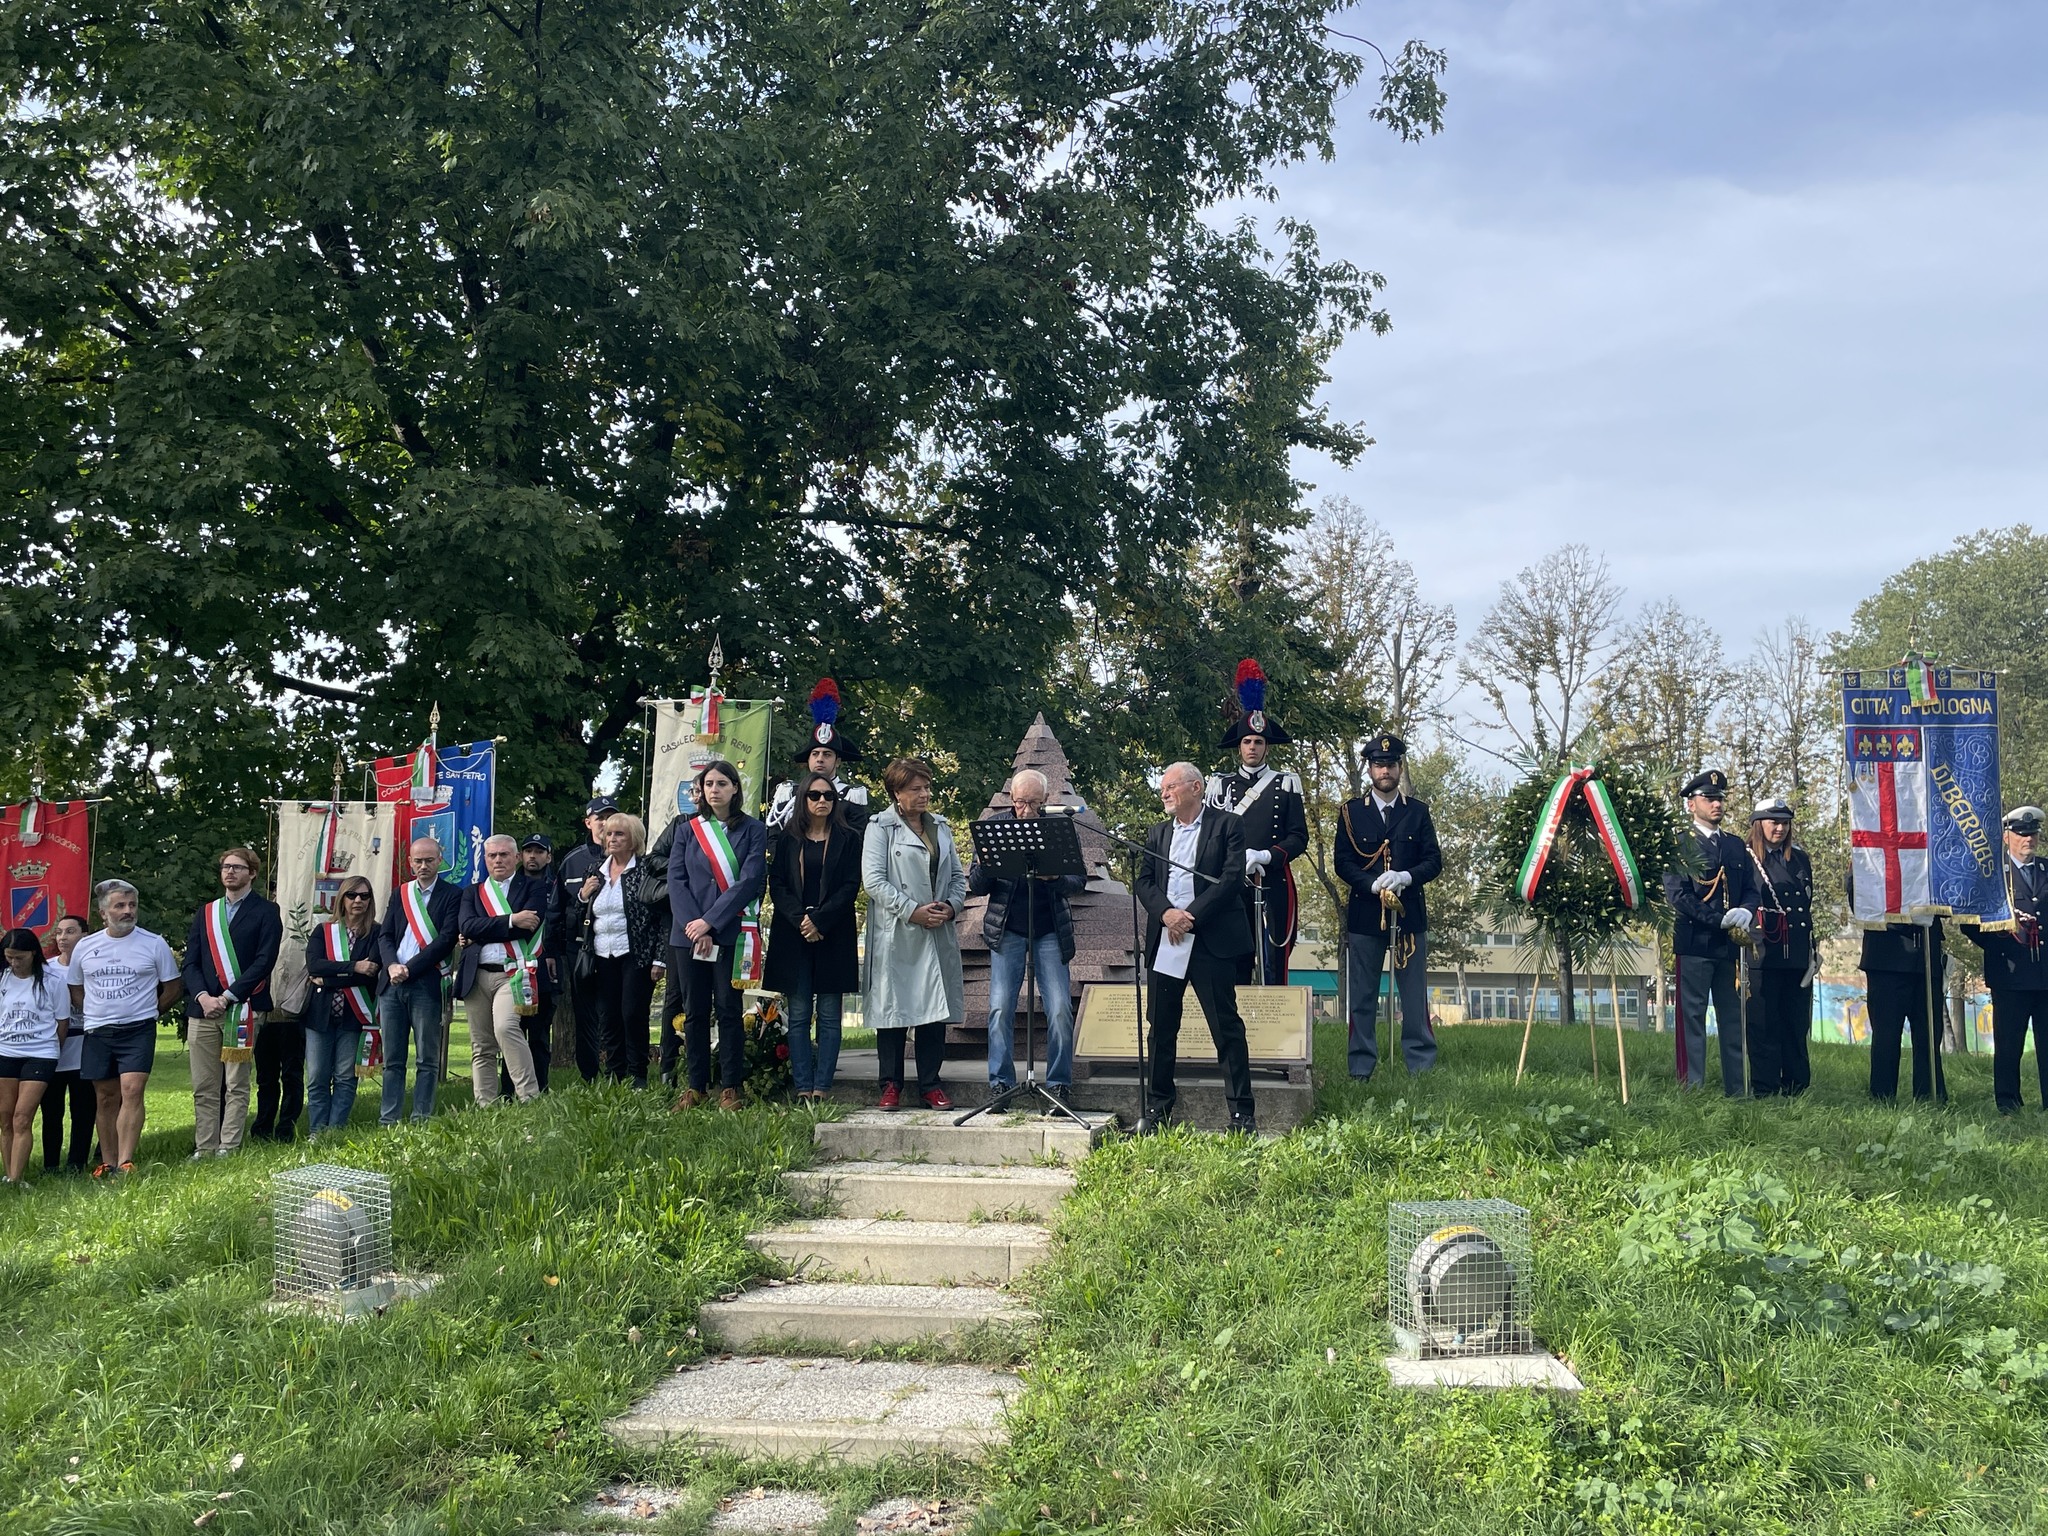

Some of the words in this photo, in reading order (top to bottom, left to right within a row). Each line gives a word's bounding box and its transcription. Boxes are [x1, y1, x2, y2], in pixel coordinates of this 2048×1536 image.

[1851, 697, 1892, 715] CITTA'
[1901, 704, 1911, 715] DI
[1921, 697, 1993, 716] BOLOGNA
[660, 734, 696, 754] CASALEC
[730, 738, 753, 755] RENO
[445, 771, 460, 780] SAN
[380, 782, 410, 798] COMUE
[1601, 813, 1610, 828] DI
[1607, 827, 1634, 884] BOLOGNA
[91, 965, 137, 978] STAFFETTA
[96, 977, 133, 988] VITTIME
[106, 986, 140, 1000] BIANCA
